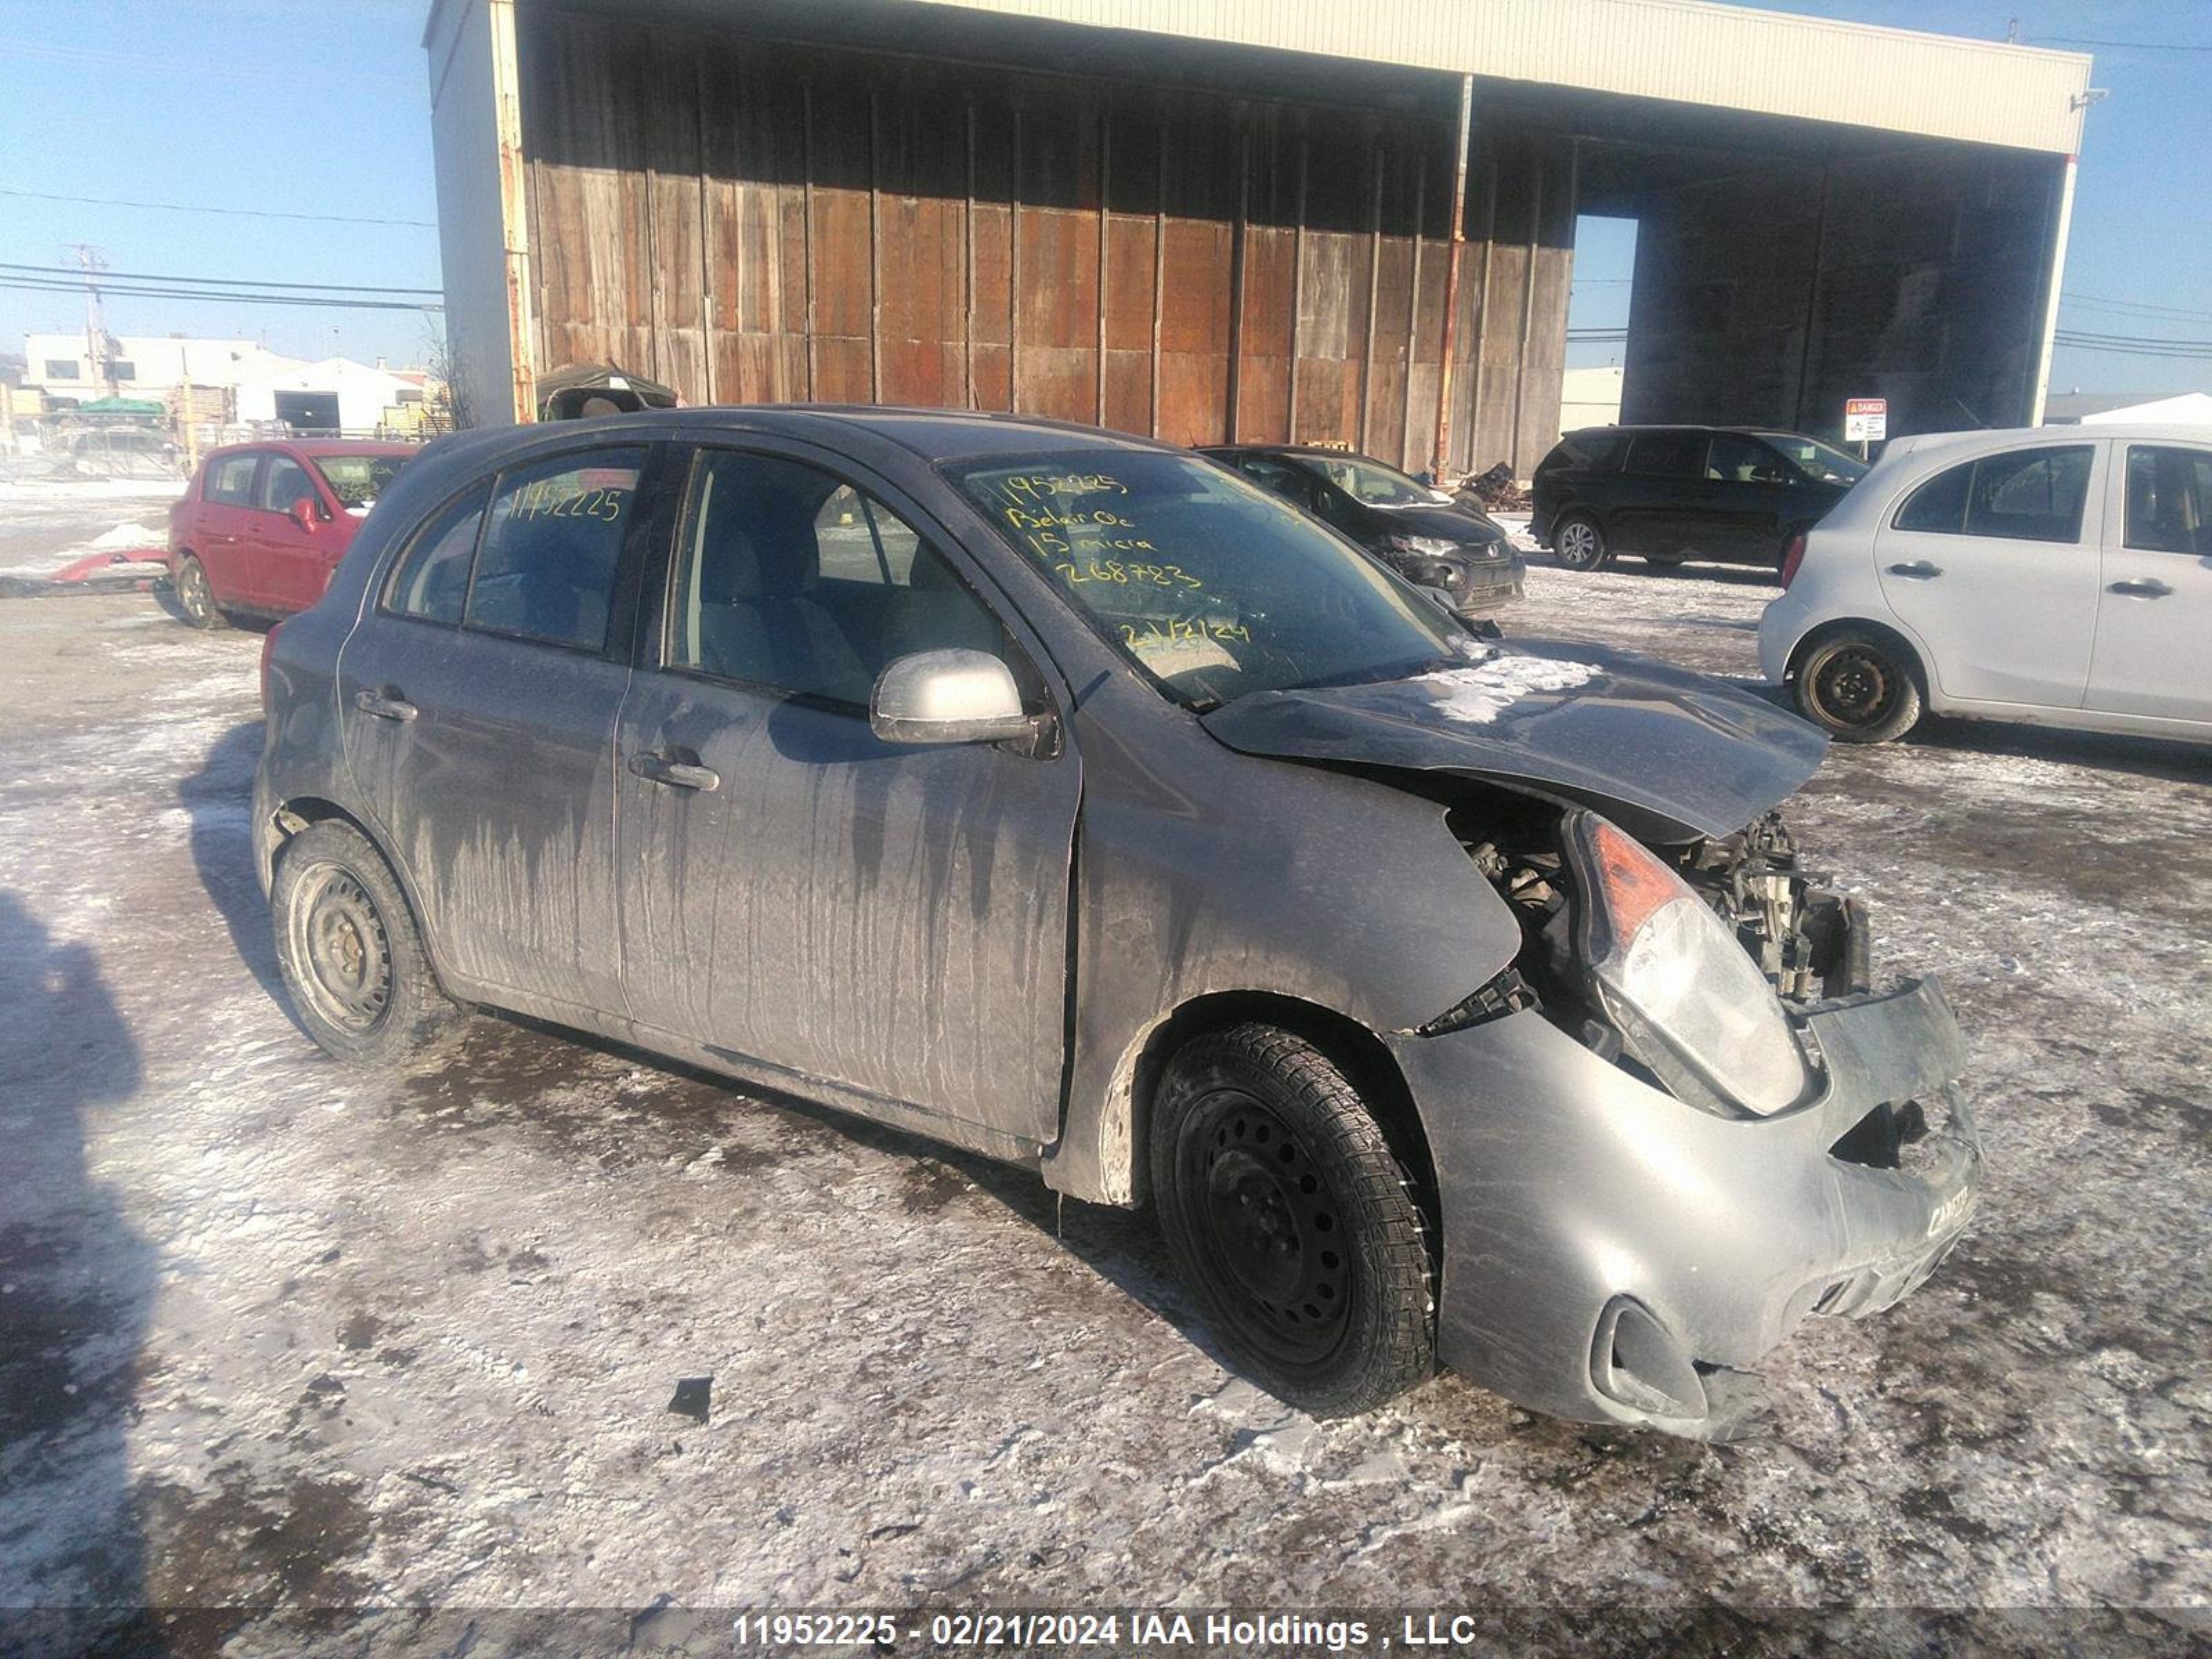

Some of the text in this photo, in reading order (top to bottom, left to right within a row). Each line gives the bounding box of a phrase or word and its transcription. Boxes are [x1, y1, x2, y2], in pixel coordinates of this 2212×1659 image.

[509, 481, 621, 521] 11952225
[1028, 533, 1070, 557] 15
[1055, 563, 1201, 588] 268783
